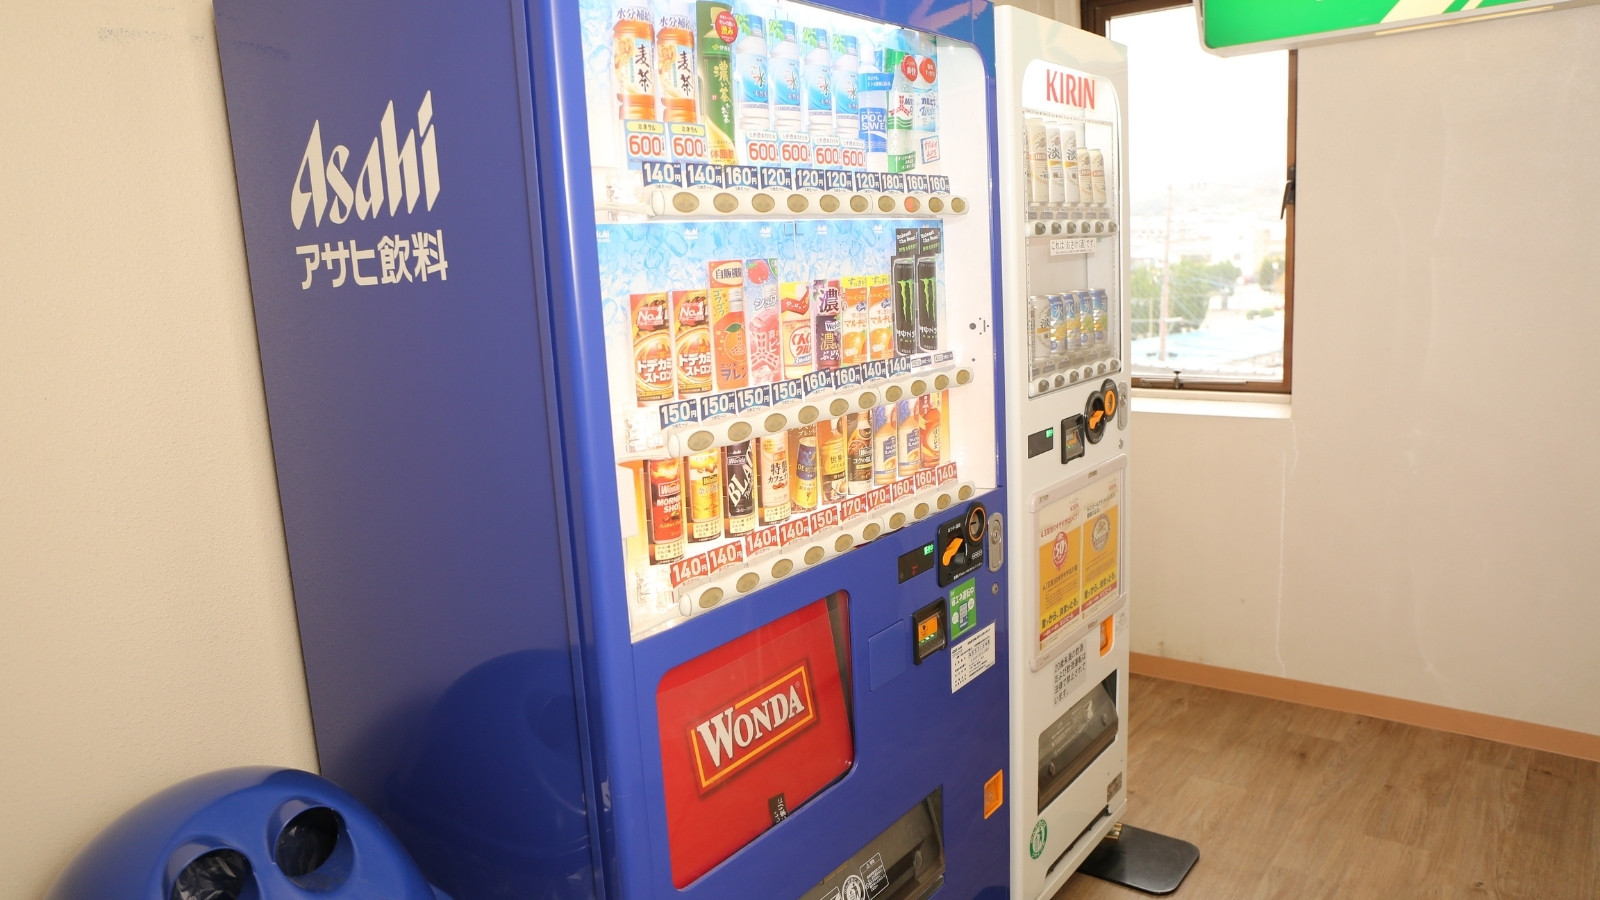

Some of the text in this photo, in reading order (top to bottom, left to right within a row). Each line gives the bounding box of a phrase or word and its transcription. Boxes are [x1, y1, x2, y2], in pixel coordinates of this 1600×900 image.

[635, 44, 652, 92] 麦茶
[677, 51, 695, 96] 麦茶
[1046, 69, 1095, 110] KIRIN
[629, 135, 662, 157] 600
[673, 137, 704, 158] 600
[748, 143, 777, 161] 600
[782, 143, 808, 162] 600
[815, 147, 839, 164] 600
[291, 90, 440, 230] Asahi
[842, 149, 864, 167] 600
[644, 163, 682, 183] 140円
[687, 164, 723, 184] 140円
[726, 166, 758, 185] 160円
[761, 167, 792, 186] 120円
[797, 169, 825, 187] 120円
[827, 170, 852, 188] 120円
[856, 172, 880, 189] 120円
[296, 230, 448, 290] アサヒ飲料
[697, 685, 805, 767] WONDA
